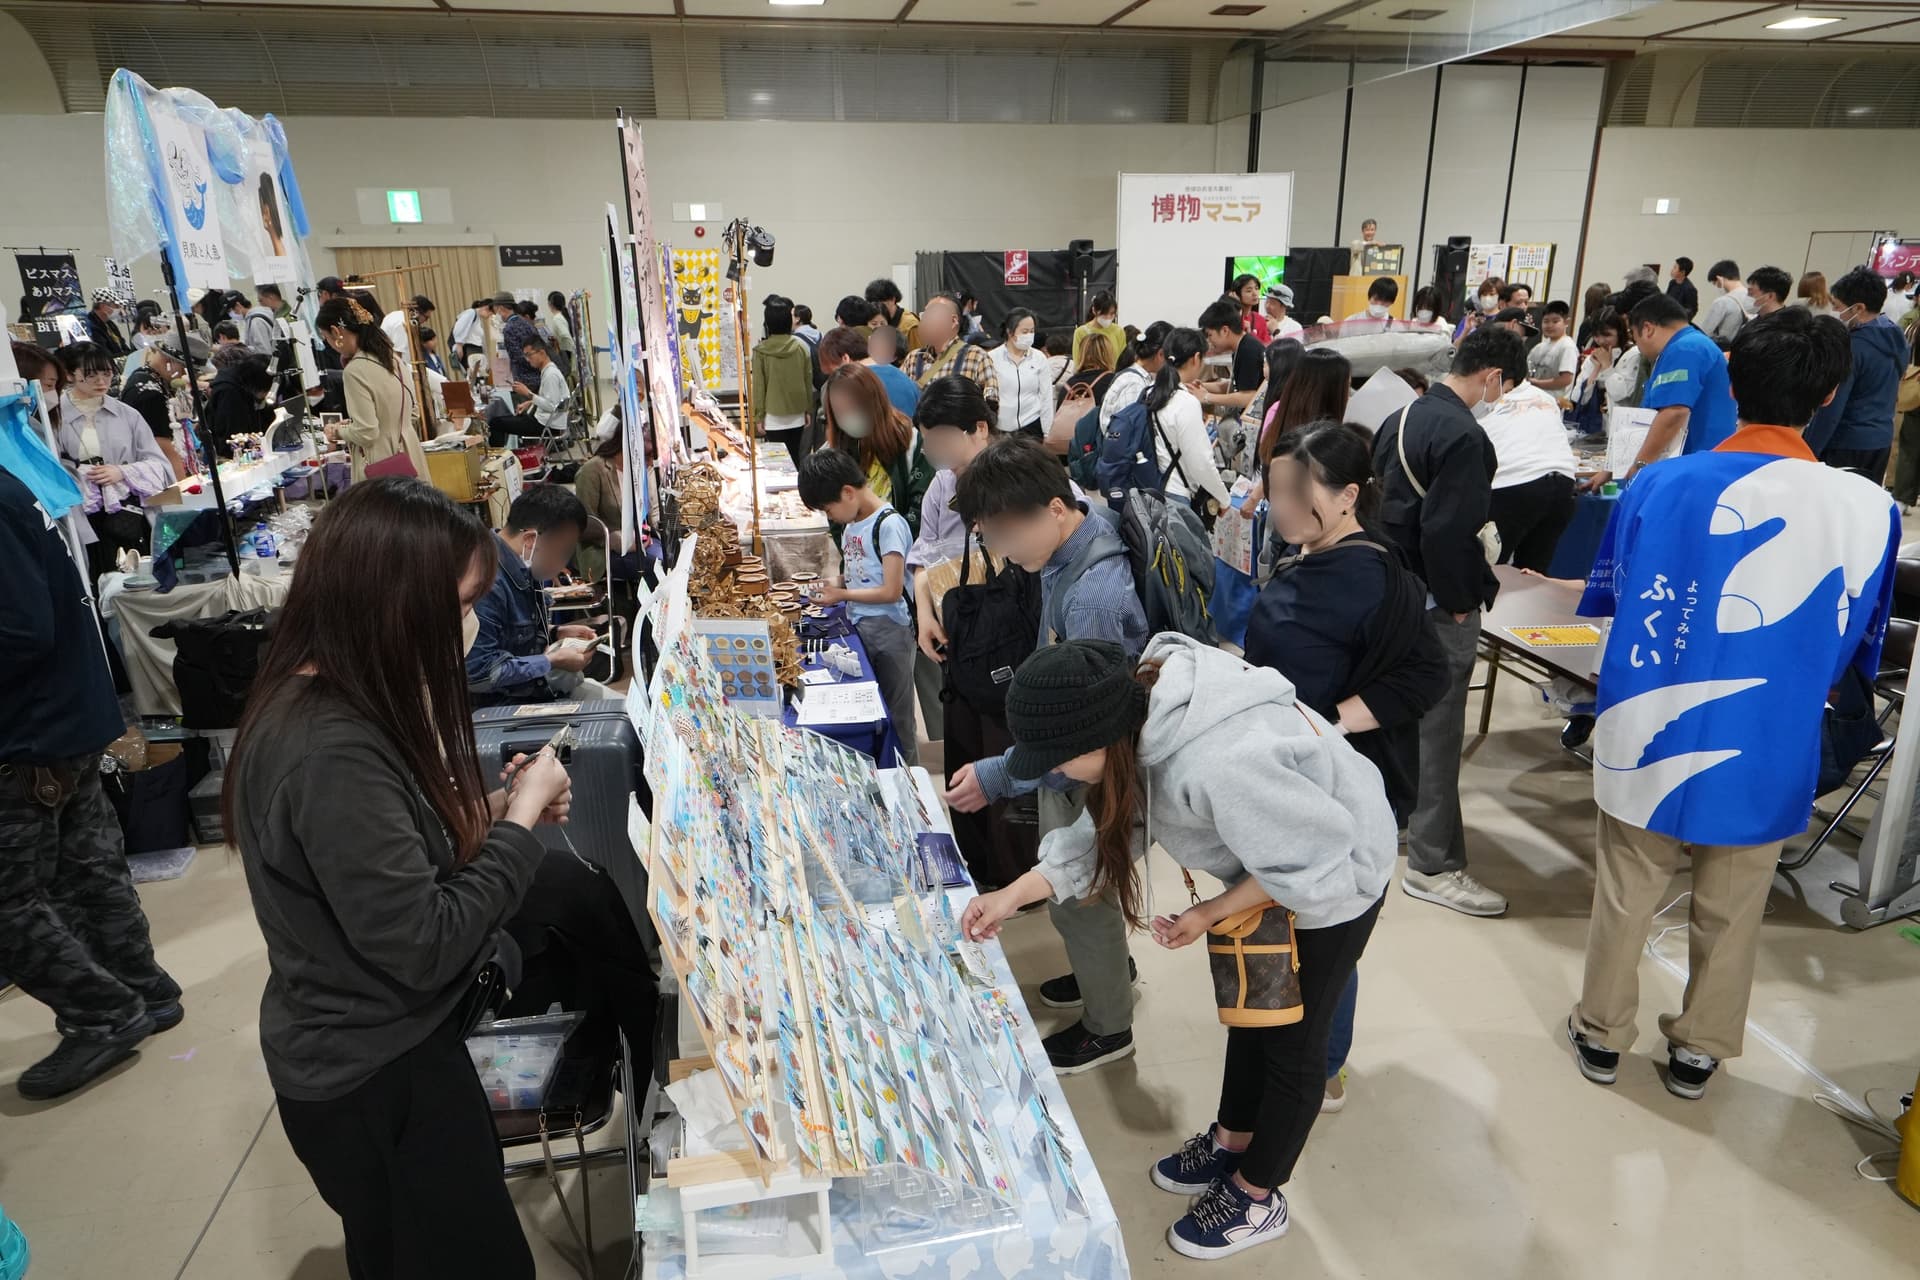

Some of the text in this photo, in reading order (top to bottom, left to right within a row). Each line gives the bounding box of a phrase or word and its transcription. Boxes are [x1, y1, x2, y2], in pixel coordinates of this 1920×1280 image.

[1151, 193, 1262, 223] 博物マニア
[25, 268, 78, 280] ビスマス、
[31, 286, 80, 297] ありマス。
[1629, 573, 1676, 668] ふくい
[1673, 580, 1698, 665] よってみね!
